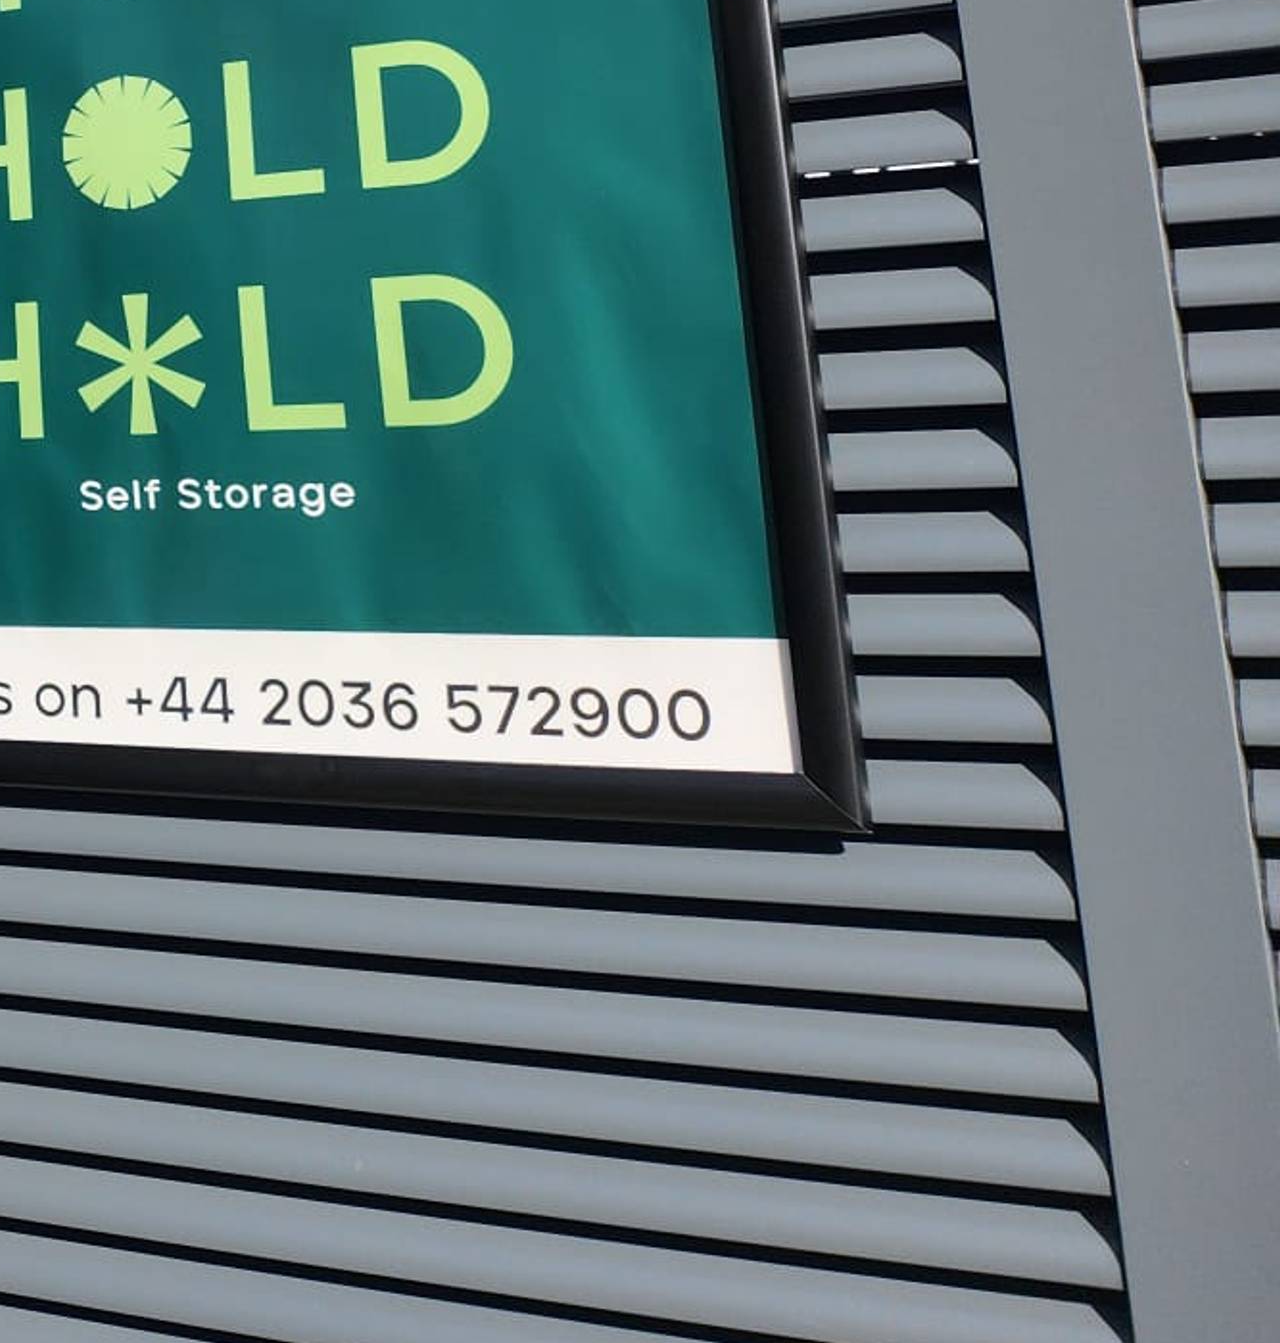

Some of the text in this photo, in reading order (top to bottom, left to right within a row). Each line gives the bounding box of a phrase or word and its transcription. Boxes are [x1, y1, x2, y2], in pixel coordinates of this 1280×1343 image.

[78, 476, 357, 518] Self Storage
[35, 682, 102, 719] on
[125, 675, 235, 724] +44
[260, 678, 420, 732] 2036
[445, 683, 713, 743] 572900
